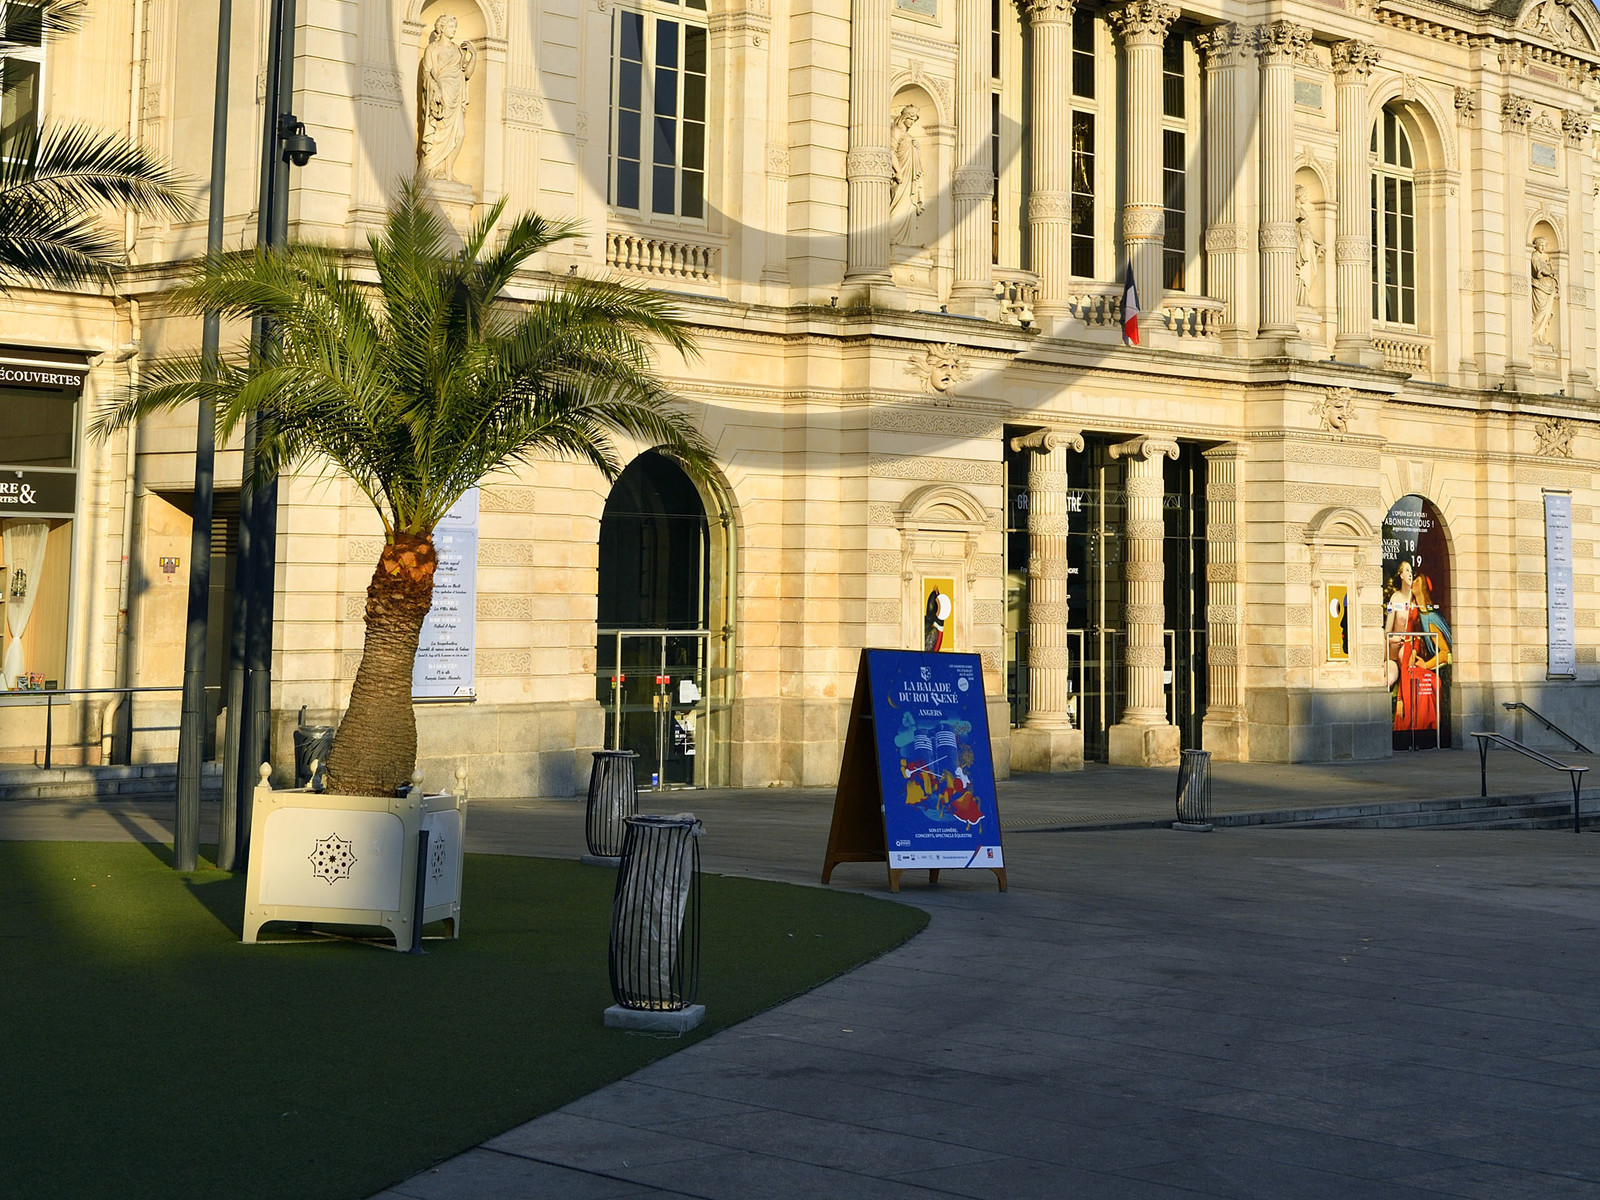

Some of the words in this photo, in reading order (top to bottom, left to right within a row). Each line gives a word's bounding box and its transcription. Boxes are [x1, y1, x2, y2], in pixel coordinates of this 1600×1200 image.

[0, 367, 81, 386] ÉCOUVERTES
[19, 483, 37, 504] &
[1385, 518, 1430, 528] ABONNEZ-VOUS
[1404, 540, 1415, 551] 18
[1411, 555, 1422, 567] 19
[903, 681, 916, 691] LA
[916, 681, 952, 693] BALADE
[899, 692, 912, 702] DU
[913, 692, 930, 703] ROI
[918, 709, 943, 717] ANGERS
